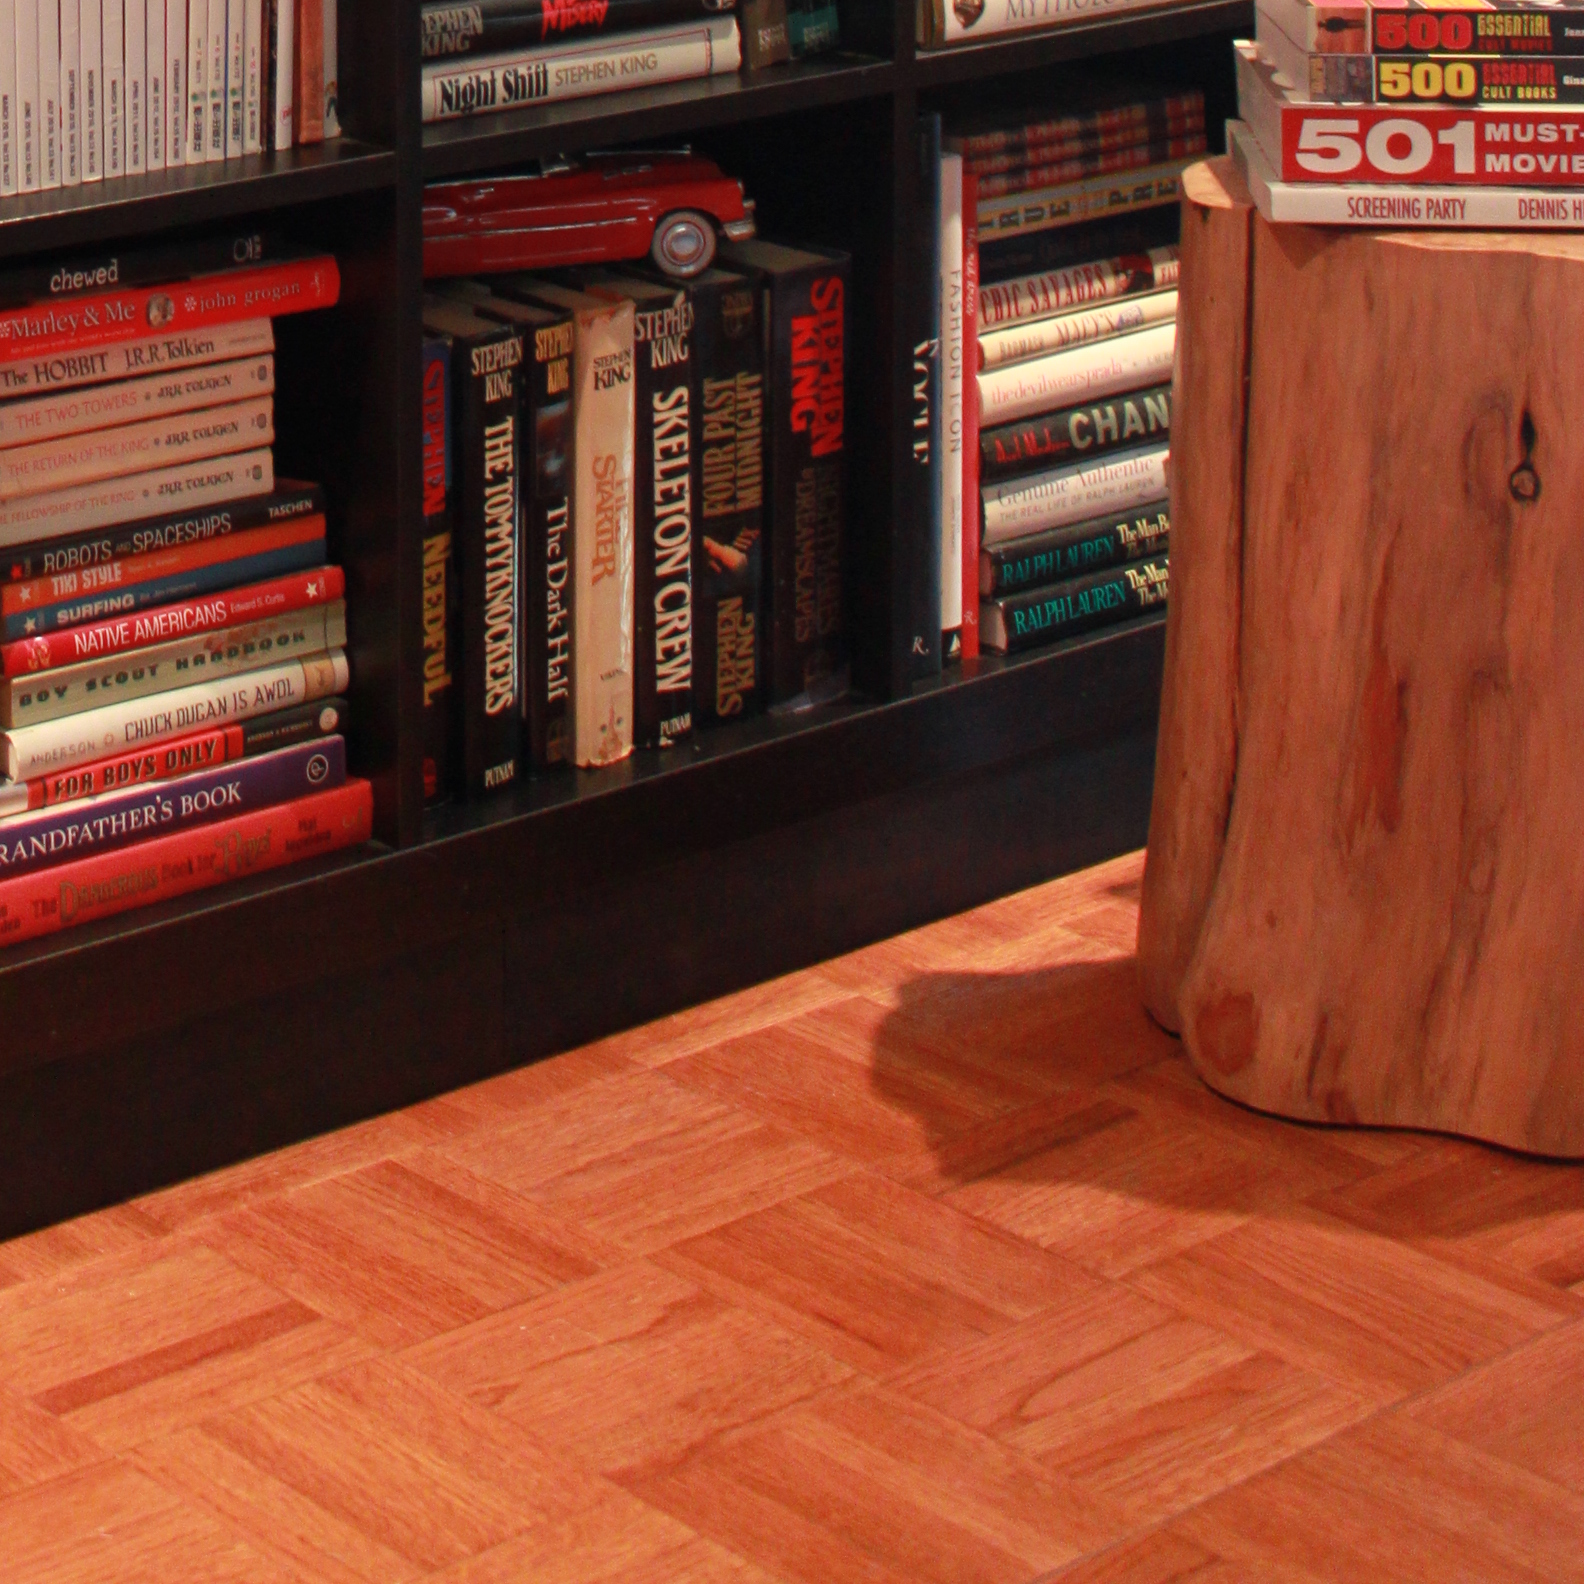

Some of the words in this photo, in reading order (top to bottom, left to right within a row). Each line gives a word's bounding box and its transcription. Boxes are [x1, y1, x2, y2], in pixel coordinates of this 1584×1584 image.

[1376, 13, 1472, 51] 500
[1477, 14, 1550, 36] ESSENTIAL
[440, 71, 496, 114] Night
[503, 63, 548, 110] Shift
[555, 60, 616, 87] STEPHEN
[620, 53, 658, 75] KING
[1380, 62, 1476, 98] 500
[1482, 62, 1557, 85] ESSENTIAL
[1294, 118, 1476, 174] 501
[1348, 197, 1421, 220] SCREENING
[1426, 199, 1466, 220] PARTY
[1519, 199, 1566, 220] DENNIS
[50, 259, 119, 292] chewed
[791, 314, 816, 431] KING
[484, 416, 515, 479] THE
[1069, 393, 1171, 449] CHAN
[653, 385, 690, 576] SKELETON
[997, 476, 1069, 507] Genuine
[1077, 456, 1153, 488] Authentic
[44, 540, 112, 573] ROBOTS
[133, 513, 231, 553] SPACESHIPS
[269, 499, 313, 518] TASCHEN
[591, 454, 616, 586] STARTER
[56, 594, 134, 624] SURFING
[74, 623, 128, 655] NATIVE
[134, 601, 227, 643] AMERICANS
[484, 484, 517, 716] TOMMYKNOCKERS
[1014, 596, 1065, 634] RALPH
[1067, 581, 1126, 619] LAUREN
[654, 583, 692, 693] CREW
[19, 687, 67, 707] BOY
[86, 664, 158, 692] SCOUT
[176, 631, 306, 670] HANDBOOK
[54, 775, 93, 801] FOR
[103, 755, 156, 789] BOYS
[165, 739, 216, 770] ONLY
[180, 781, 241, 817] BOOK
